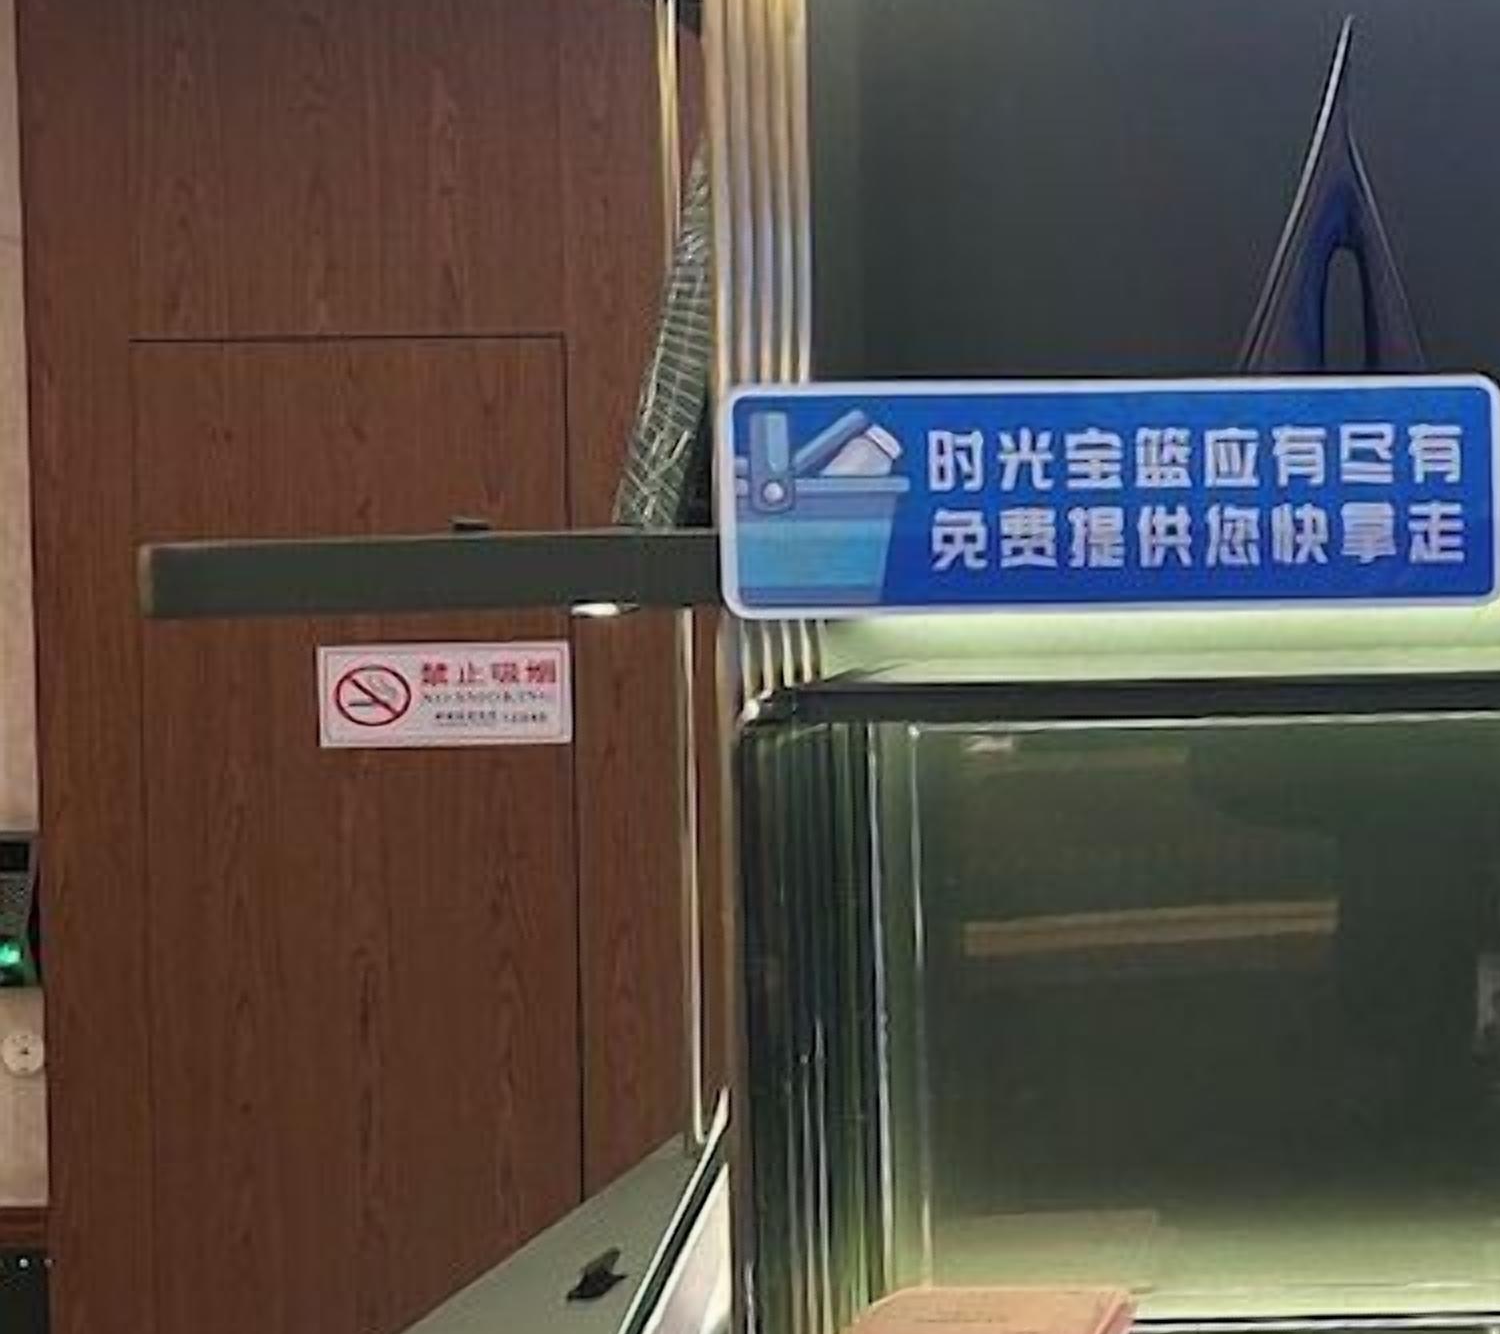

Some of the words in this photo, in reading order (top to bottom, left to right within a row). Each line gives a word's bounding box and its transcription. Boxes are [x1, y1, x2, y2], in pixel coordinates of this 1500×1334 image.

[926, 422, 1463, 493] 时光宝篮应有尽有
[930, 501, 1467, 572] 免费提供您快拿走
